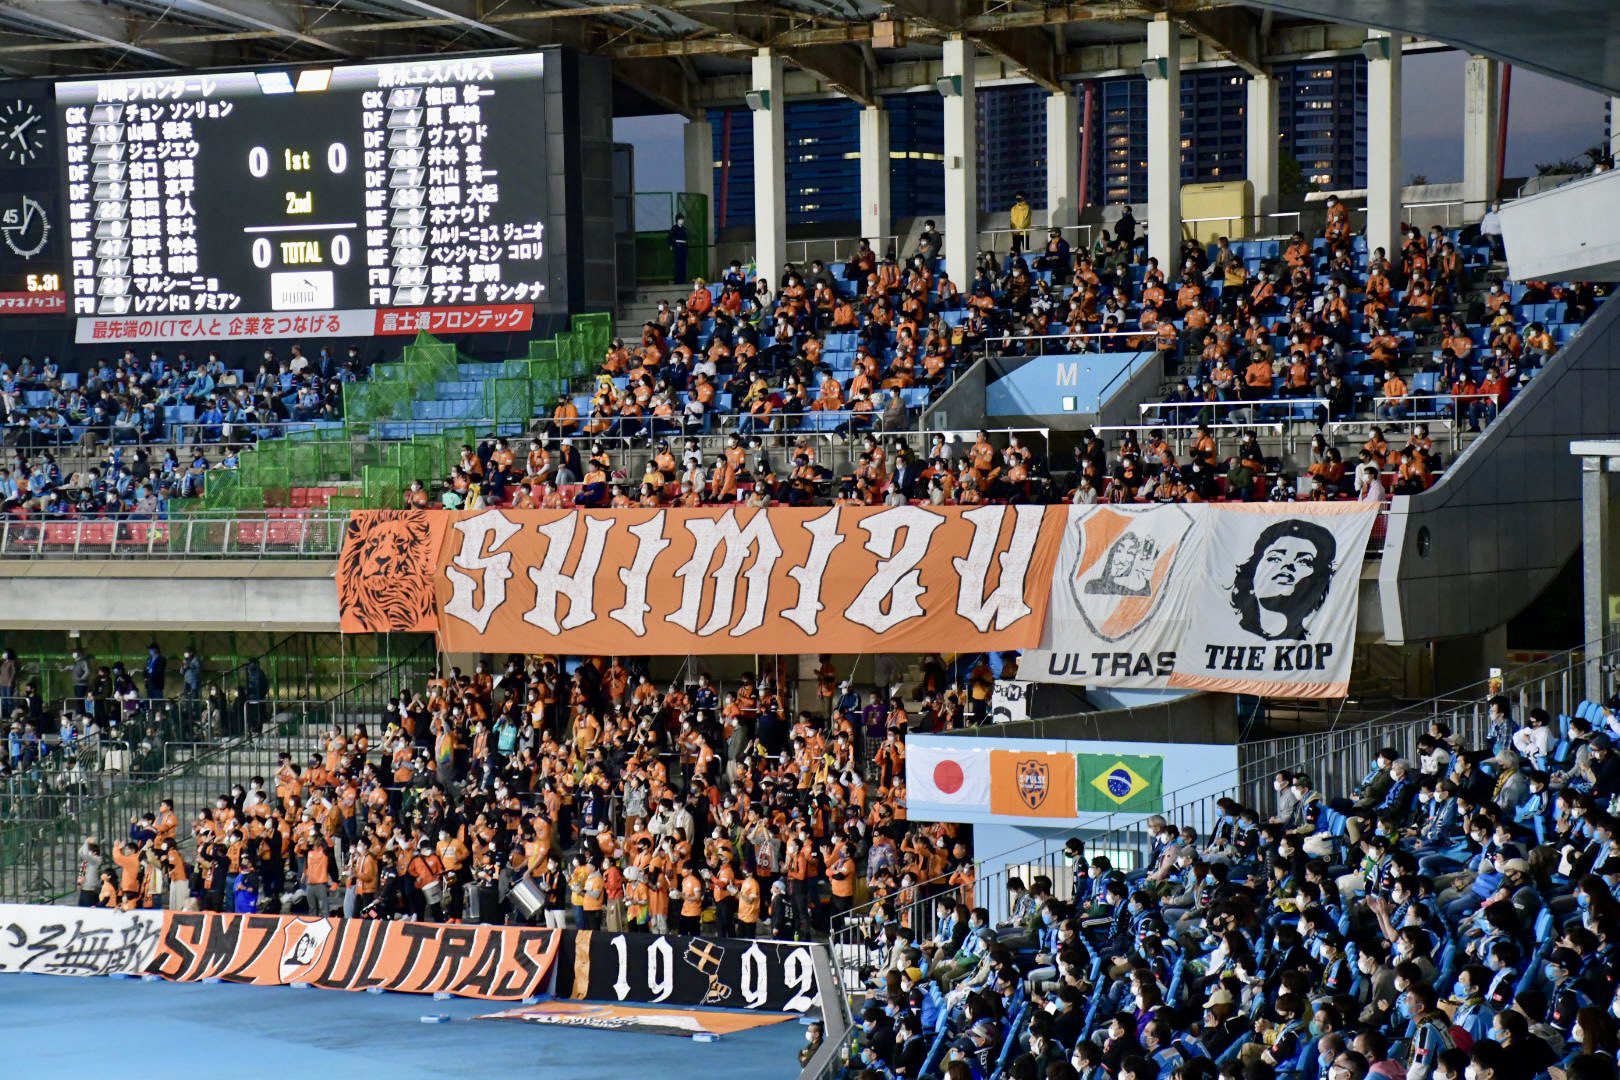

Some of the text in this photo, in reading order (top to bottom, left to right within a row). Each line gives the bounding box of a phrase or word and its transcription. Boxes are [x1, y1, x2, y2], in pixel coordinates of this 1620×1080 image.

[362, 91, 383, 108] GK
[66, 101, 232, 124] GK 1 チョン ソンリョン
[363, 111, 383, 128] DF
[406, 110, 416, 125] 4
[67, 127, 86, 143] DF
[364, 131, 384, 148] DF
[428, 125, 488, 145] ヴァウド
[68, 140, 199, 162] DF 4 ジェジエウ
[249, 143, 347, 177] 0 1st 0
[365, 151, 385, 168] DF
[428, 147, 459, 165] 井林
[69, 165, 88, 181] DF
[129, 162, 158, 179] 谷口
[366, 171, 385, 188] DF
[407, 170, 417, 185] 7
[429, 167, 459, 185] 片山
[70, 184, 89, 200] DF
[110, 183, 119, 198] 2
[366, 191, 386, 207] MF
[70, 203, 90, 219] MF
[286, 191, 312, 214] 2nd
[3, 209, 18, 223] 45
[366, 210, 387, 227] MF
[71, 222, 91, 238] MF
[367, 222, 544, 246] MF 10 カルリーニョス ジュニオ
[72, 241, 92, 257] MF
[102, 240, 122, 255] 47
[252, 235, 350, 268] 0 TOTAL 0
[368, 249, 388, 266] MF
[508, 242, 542, 260] コロリ
[73, 260, 93, 276] FW
[103, 259, 121, 274] 41
[369, 269, 390, 285] FW
[27, 274, 59, 291] 5.31
[74, 278, 94, 294] FW
[134, 276, 218, 292] マルシーニョ
[370, 288, 390, 304] FW
[432, 285, 477, 304] チアゴ
[484, 282, 545, 301] サンタナ
[75, 297, 95, 313] FW
[135, 295, 189, 312] レアンドロ
[195, 293, 240, 310] ダミアン
[92, 315, 341, 339] 最先端のICTで人と 企業をつなげる
[382, 309, 524, 332] 富士通フロンテック
[1056, 362, 1079, 386] M
[444, 504, 1045, 637] SHIMIZU
[1048, 651, 1177, 677] ULTRAS
[1205, 642, 1334, 671] THE KOP
[146, 912, 555, 997] SMZ ULTRAS
